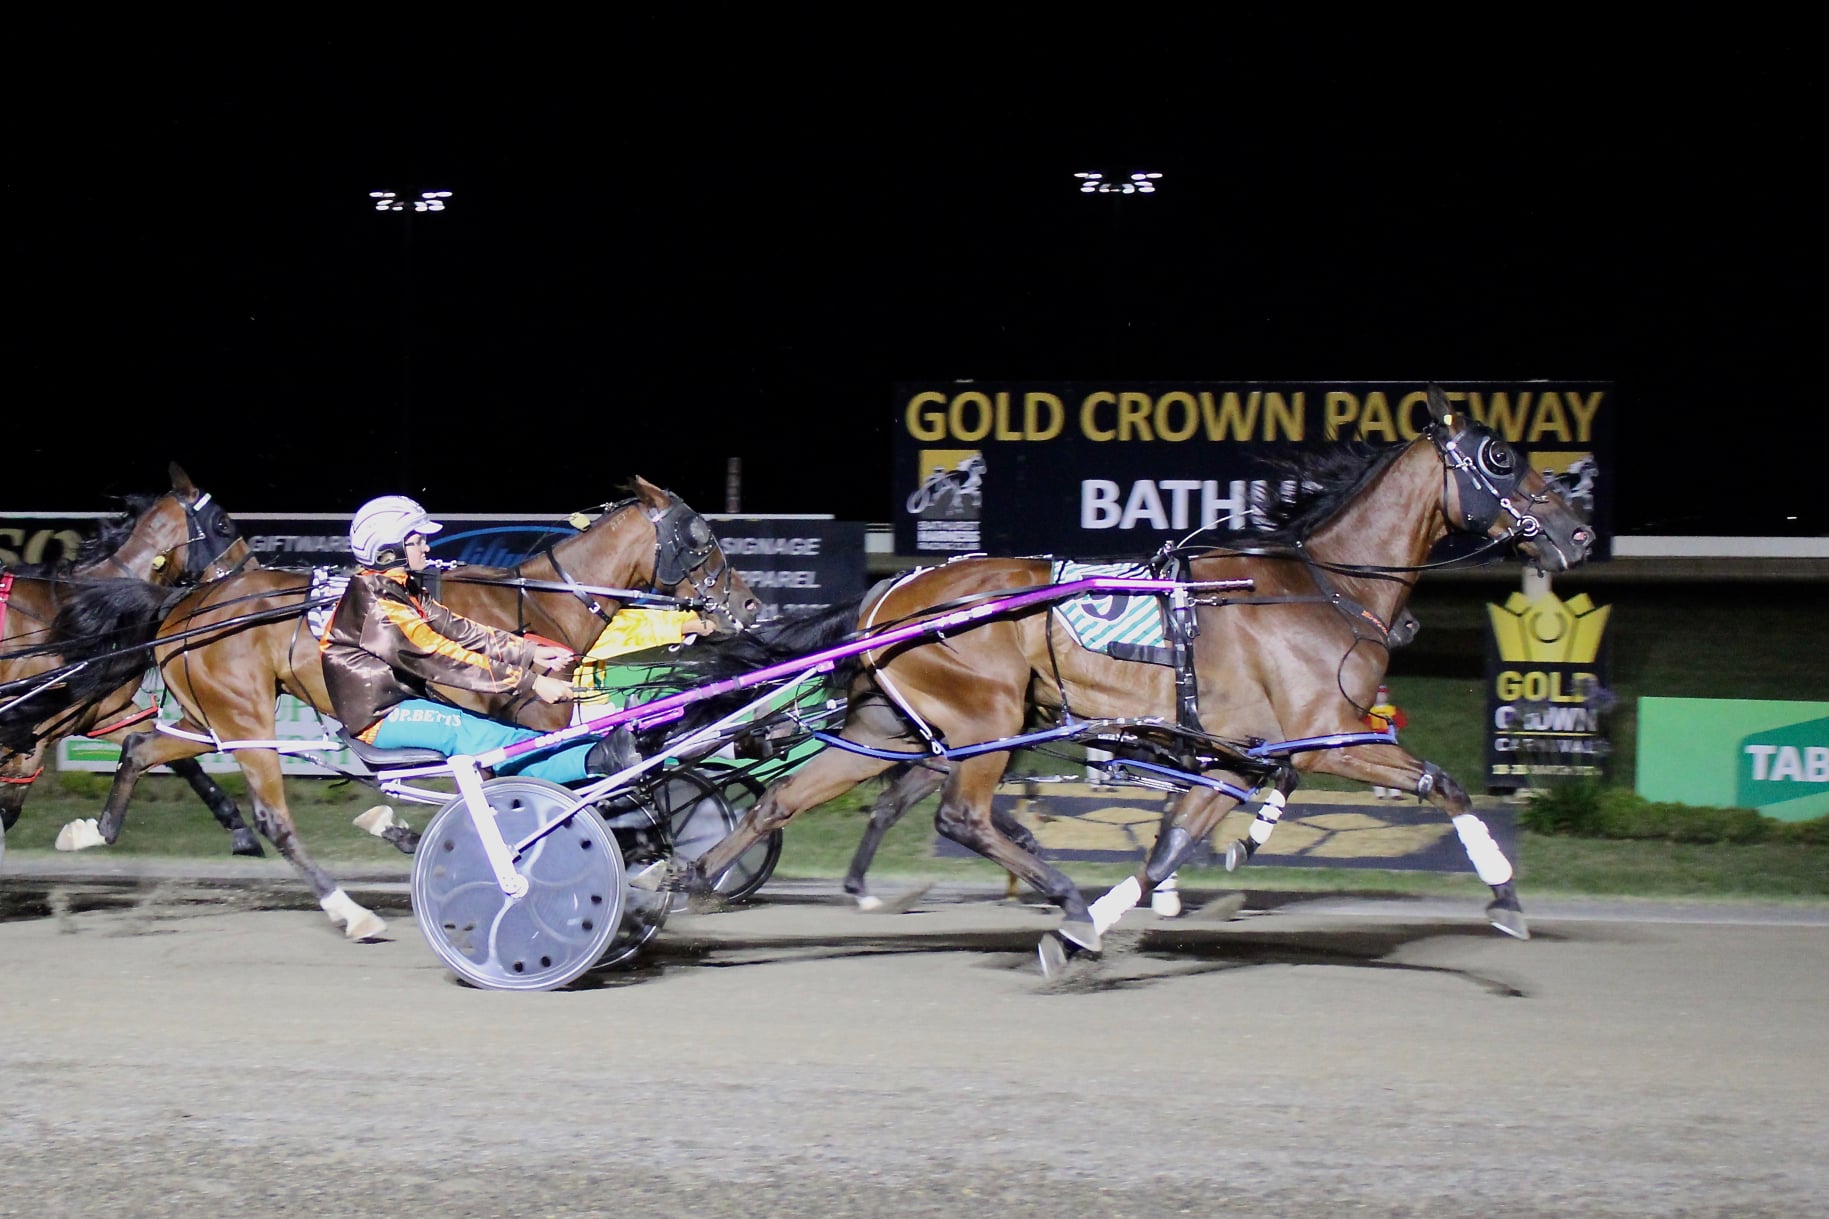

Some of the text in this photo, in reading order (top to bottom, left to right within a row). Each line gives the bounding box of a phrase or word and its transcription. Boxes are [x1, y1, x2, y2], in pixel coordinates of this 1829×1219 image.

[906, 391, 1064, 442] GOLD
[1080, 391, 1304, 442] CROWN
[721, 538, 821, 555] SIGNAGE
[734, 570, 821, 588] PPAREL
[1494, 705, 1599, 731] COWN
[1744, 744, 1829, 782] TAB
